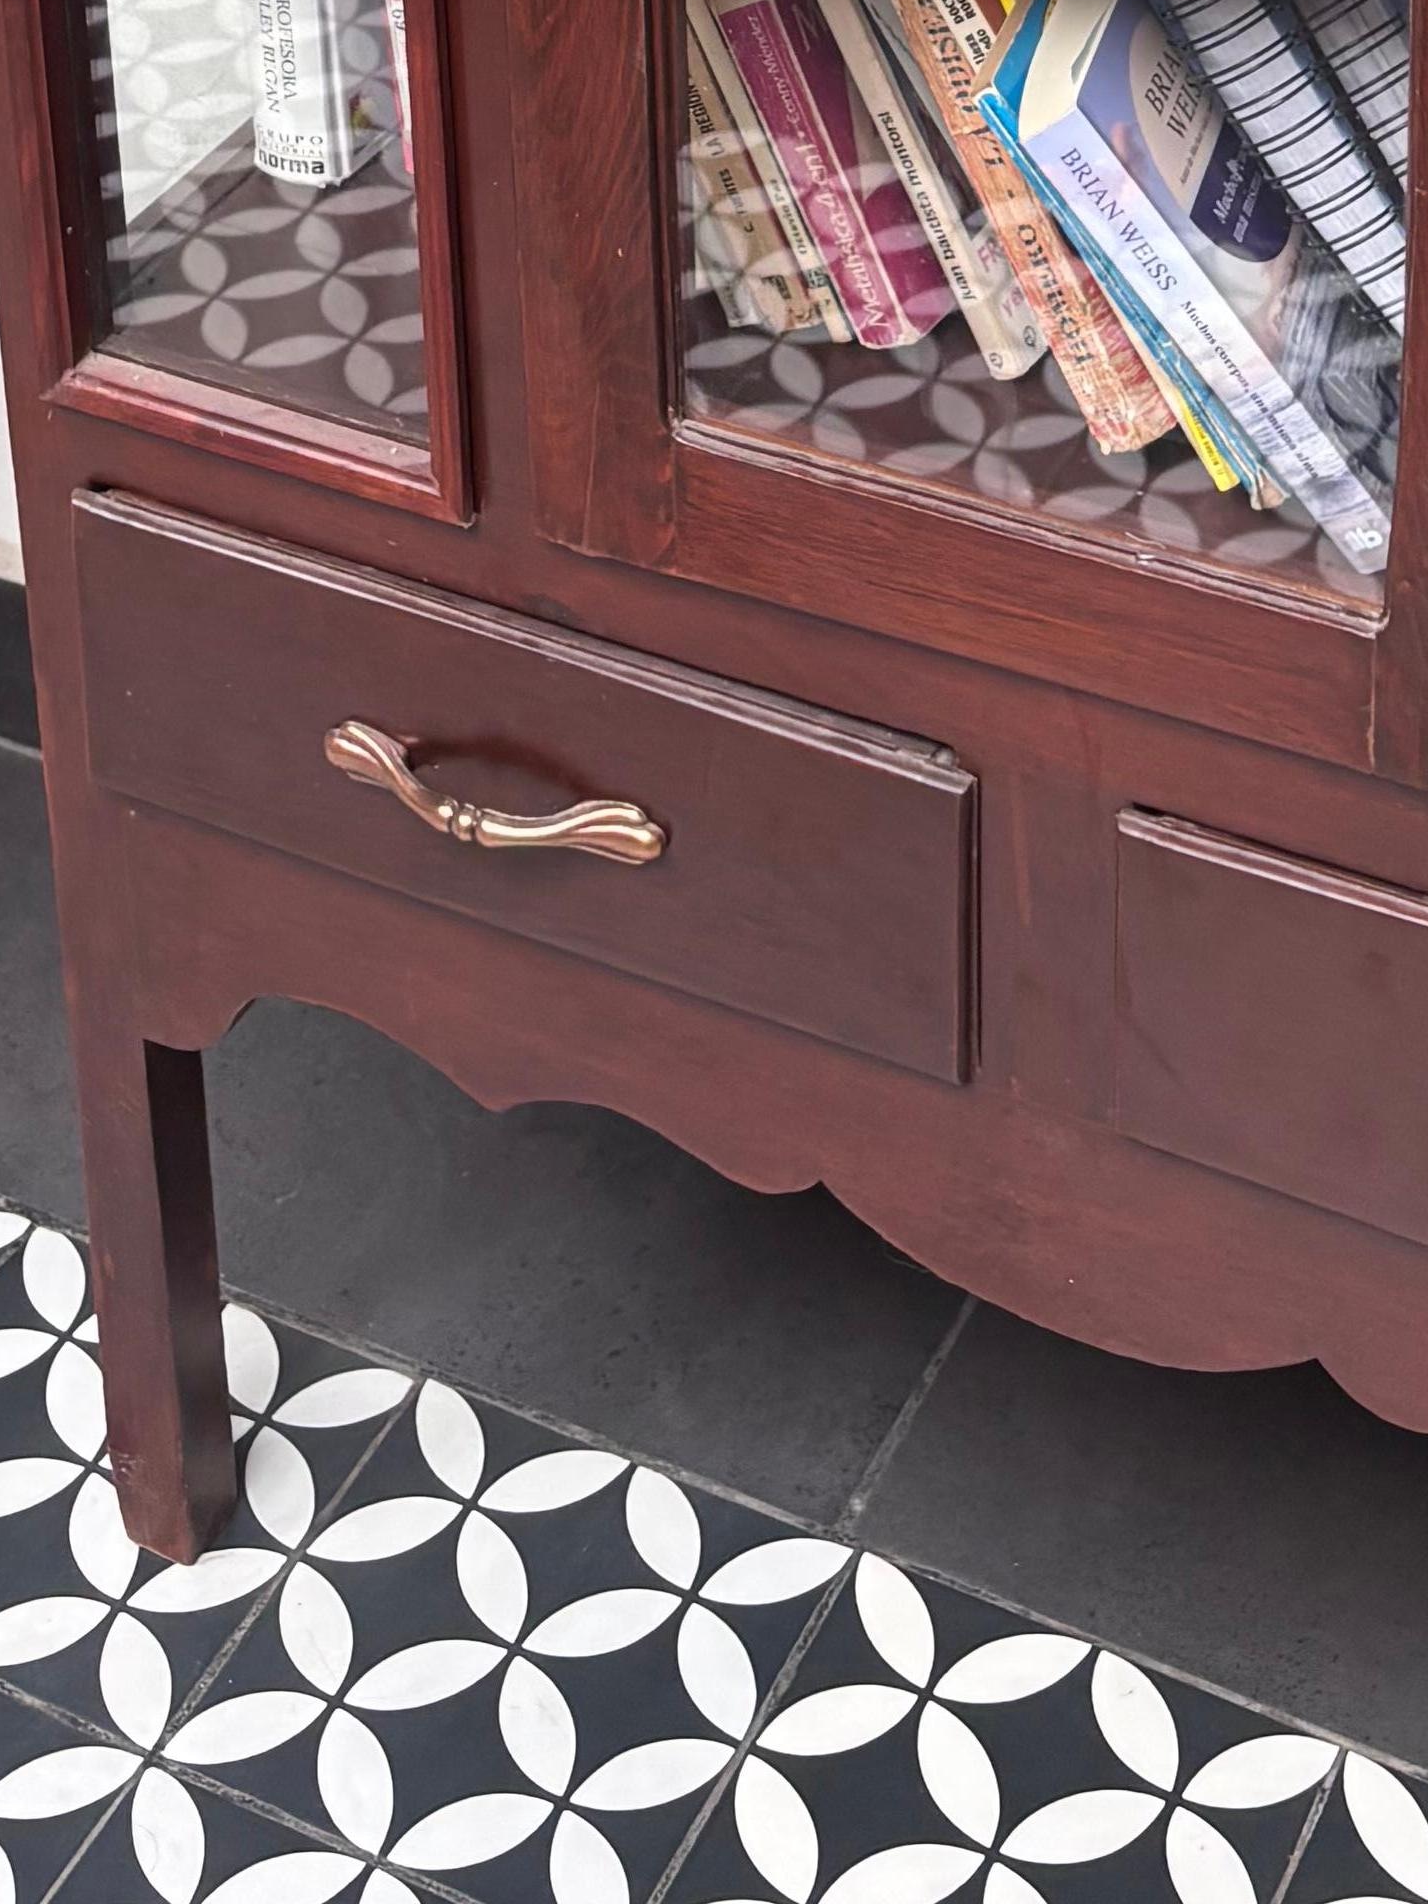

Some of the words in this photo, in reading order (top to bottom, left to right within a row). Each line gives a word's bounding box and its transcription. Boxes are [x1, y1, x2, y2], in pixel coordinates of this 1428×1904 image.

[258, 42, 284, 115] REGAN
[766, 72, 806, 126] Conny
[255, 146, 327, 179] norma
[705, 135, 726, 158] LA
[800, 149, 830, 189] en
[812, 188, 840, 213] 4
[913, 188, 957, 264] bautista
[1057, 143, 1126, 226] BRIAN
[1113, 217, 1180, 296] WEISS
[946, 261, 977, 304] juan
[1012, 218, 1095, 367] HOMERO
[1177, 296, 1221, 347] Muchos
